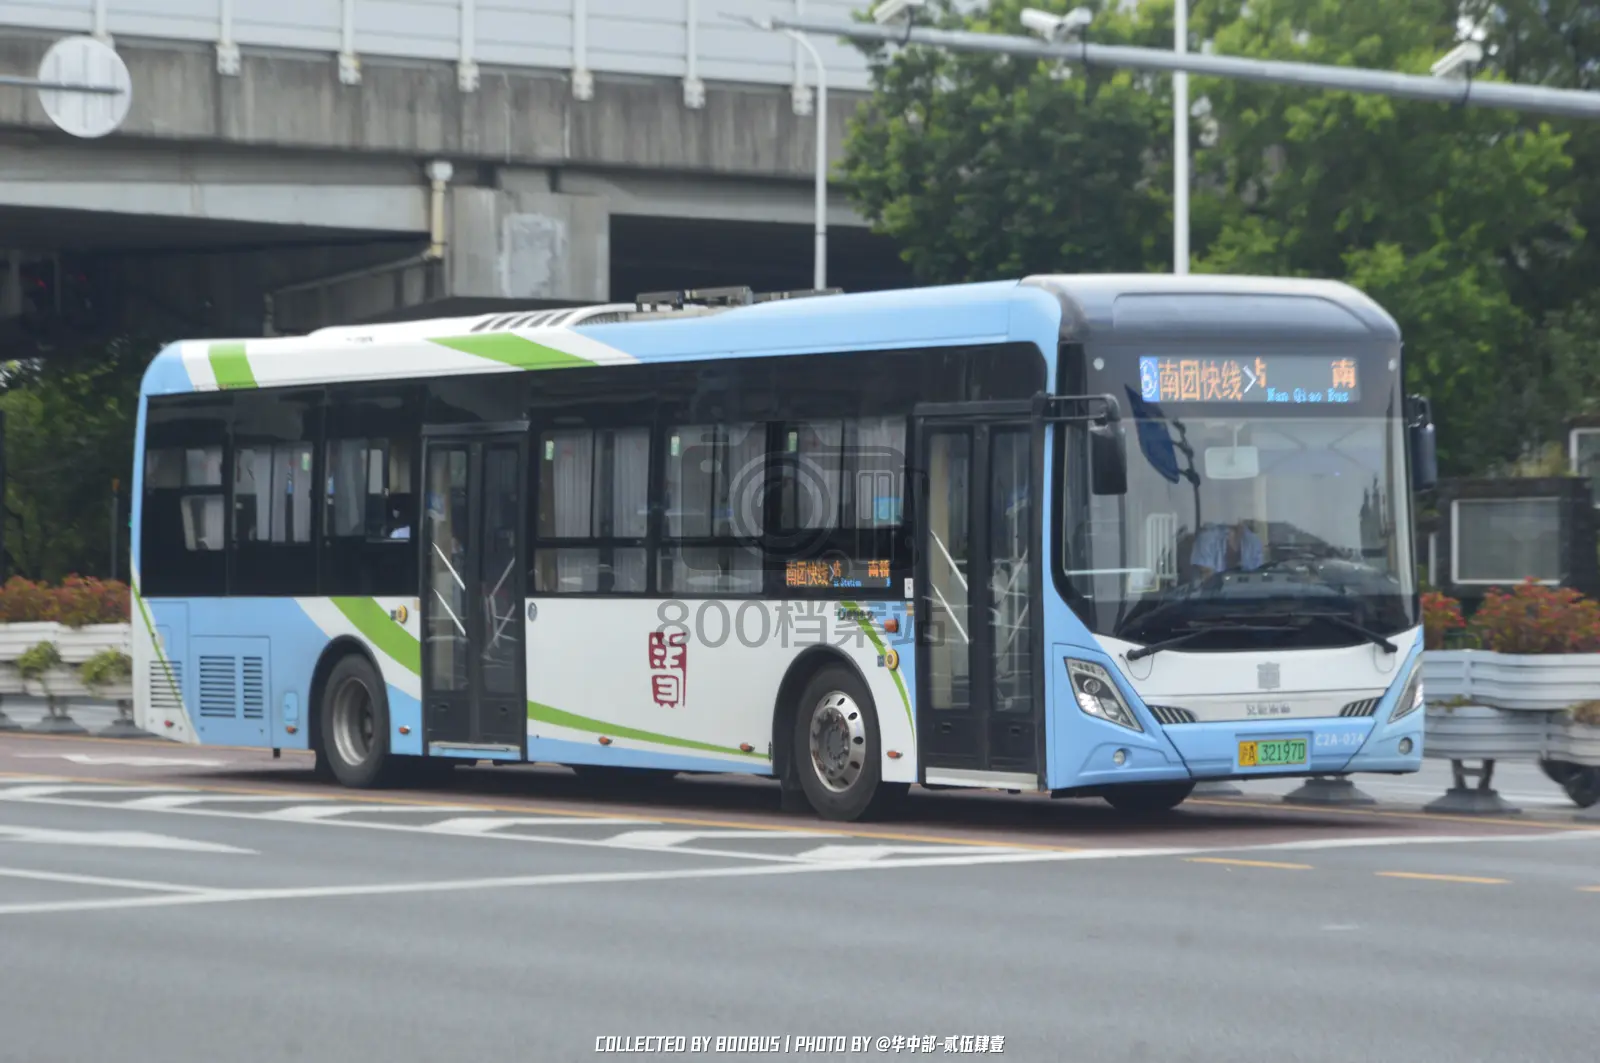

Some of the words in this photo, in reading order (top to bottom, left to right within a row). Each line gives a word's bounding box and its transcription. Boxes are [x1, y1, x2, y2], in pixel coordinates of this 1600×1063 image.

[1158, 359, 1243, 401] 南团快线
[1261, 743, 1305, 762] 32197D
